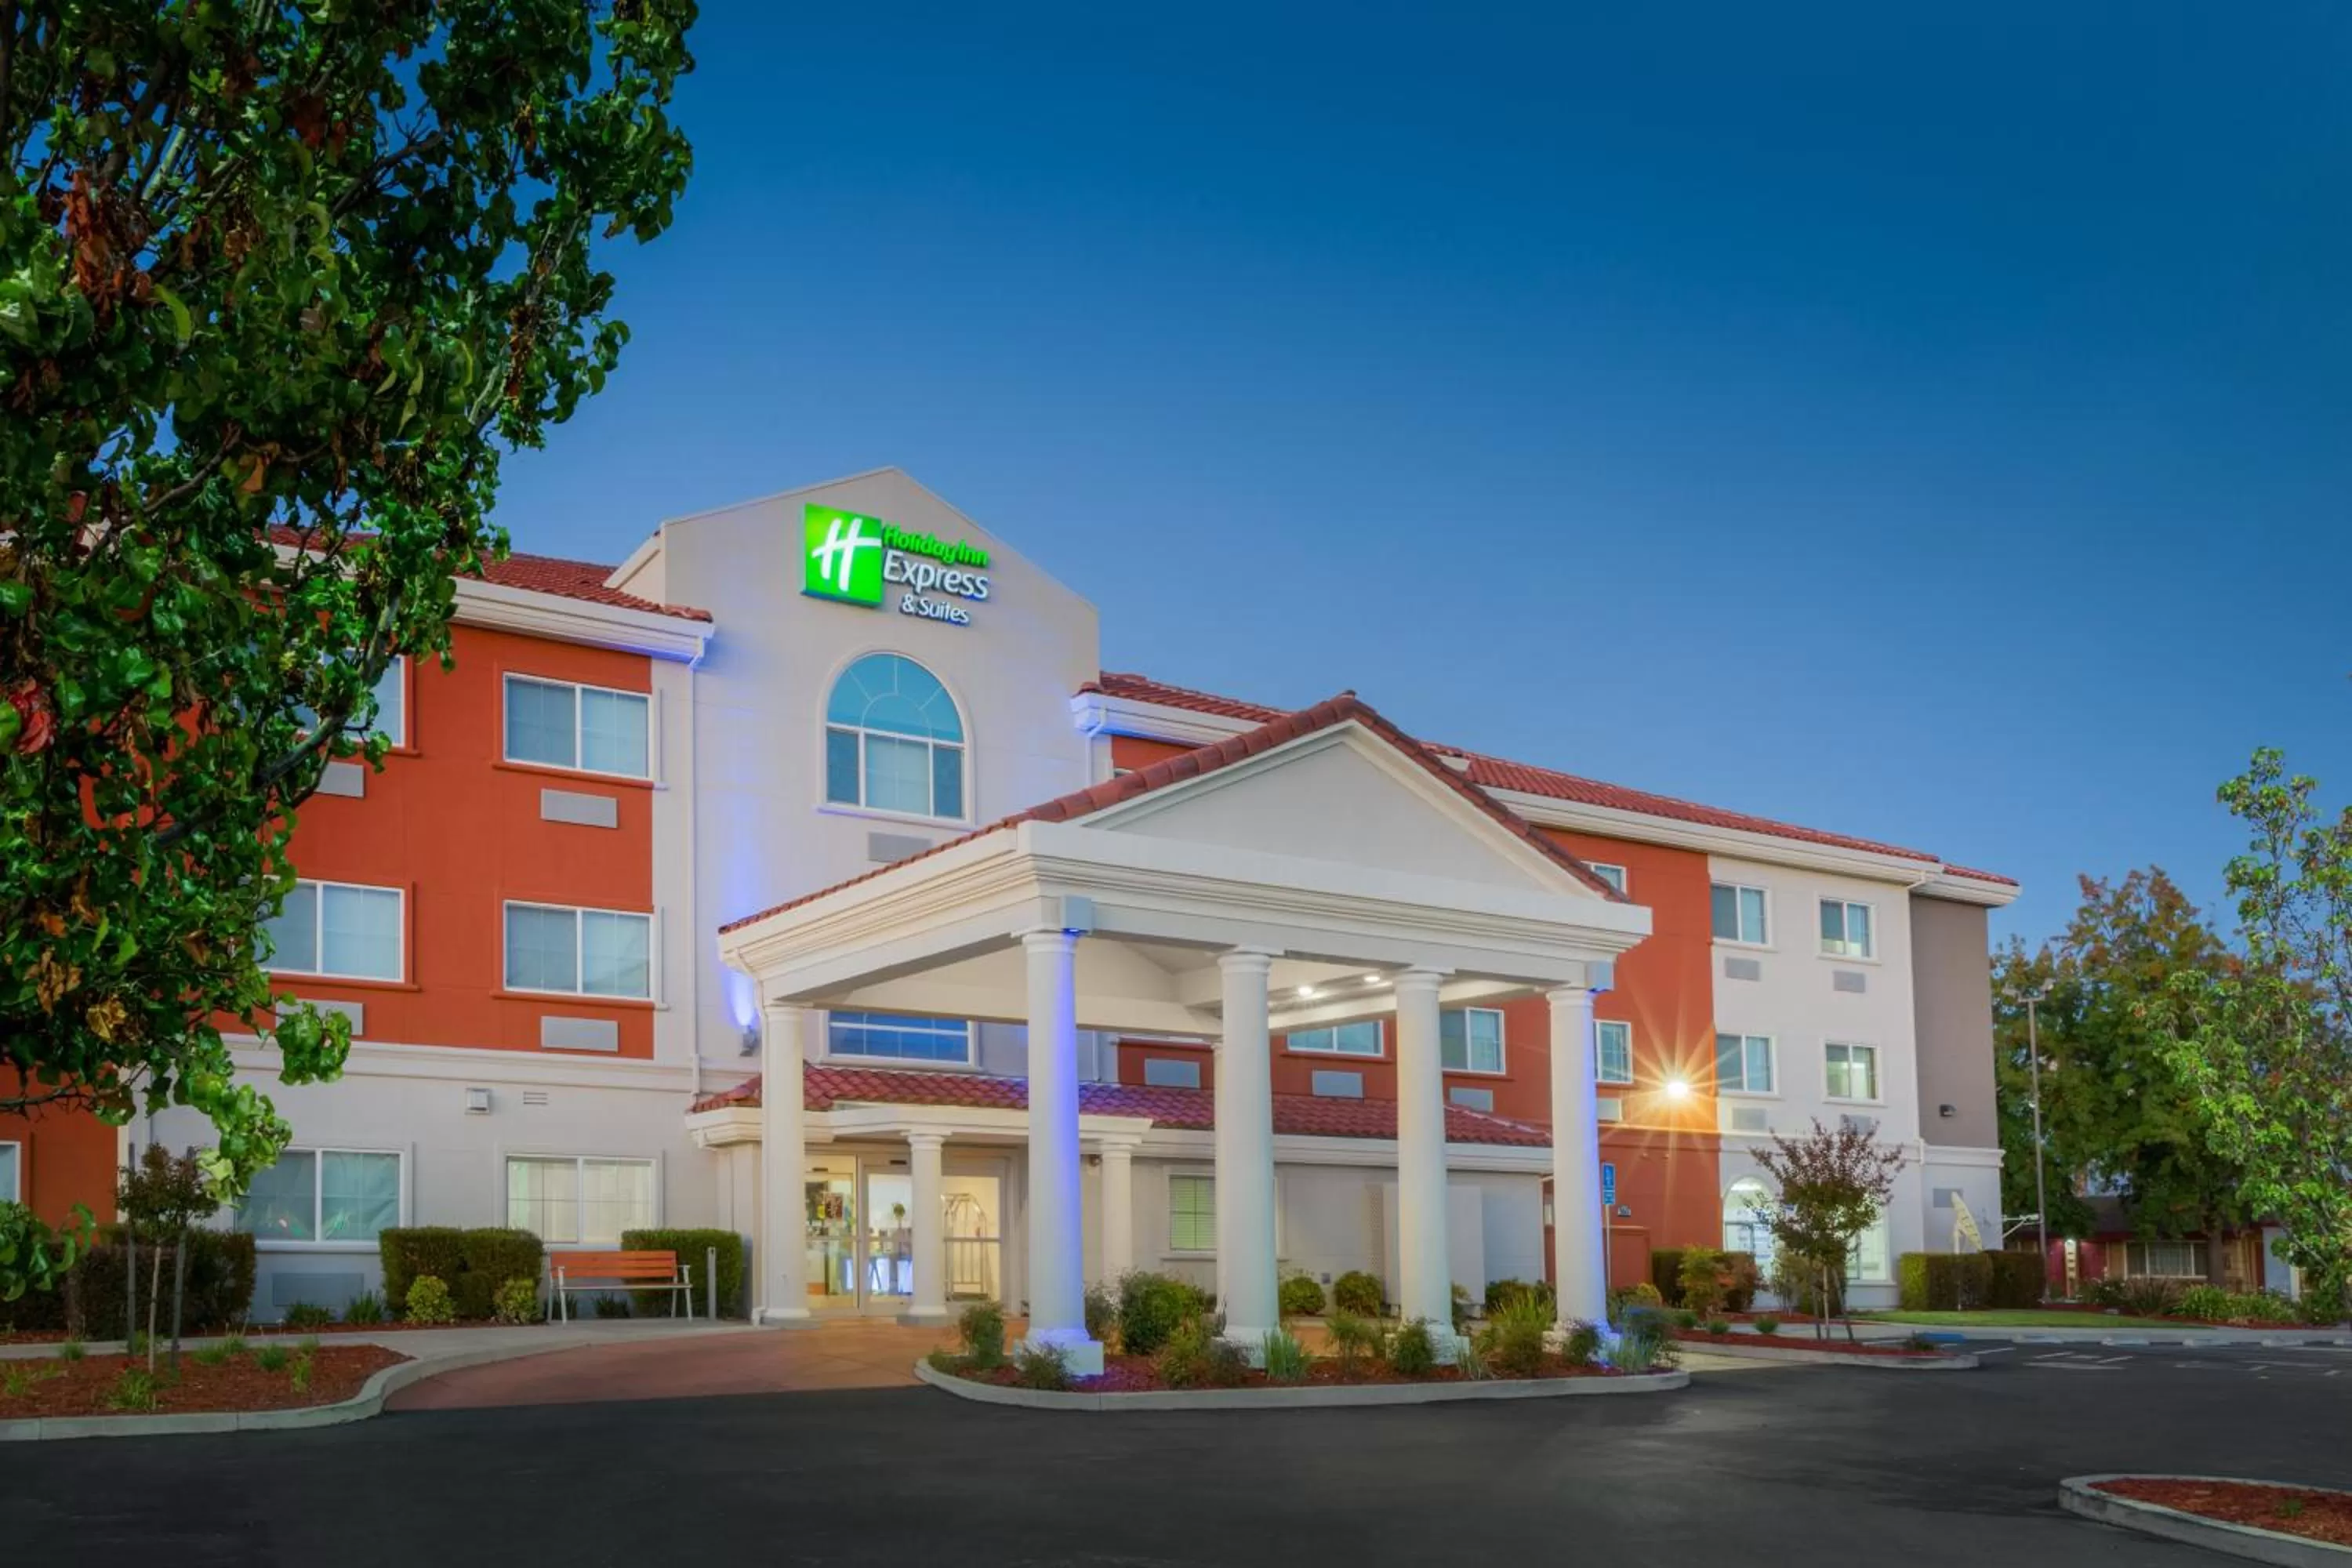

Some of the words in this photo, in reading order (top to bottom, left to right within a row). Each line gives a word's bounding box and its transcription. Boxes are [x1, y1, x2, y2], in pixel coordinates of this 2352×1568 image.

[811, 518, 881, 592] H
[884, 526, 954, 564] Holiday
[958, 539, 989, 565] Inn
[884, 550, 989, 598] Express
[902, 593, 915, 613] &
[919, 598, 969, 624] Suites
